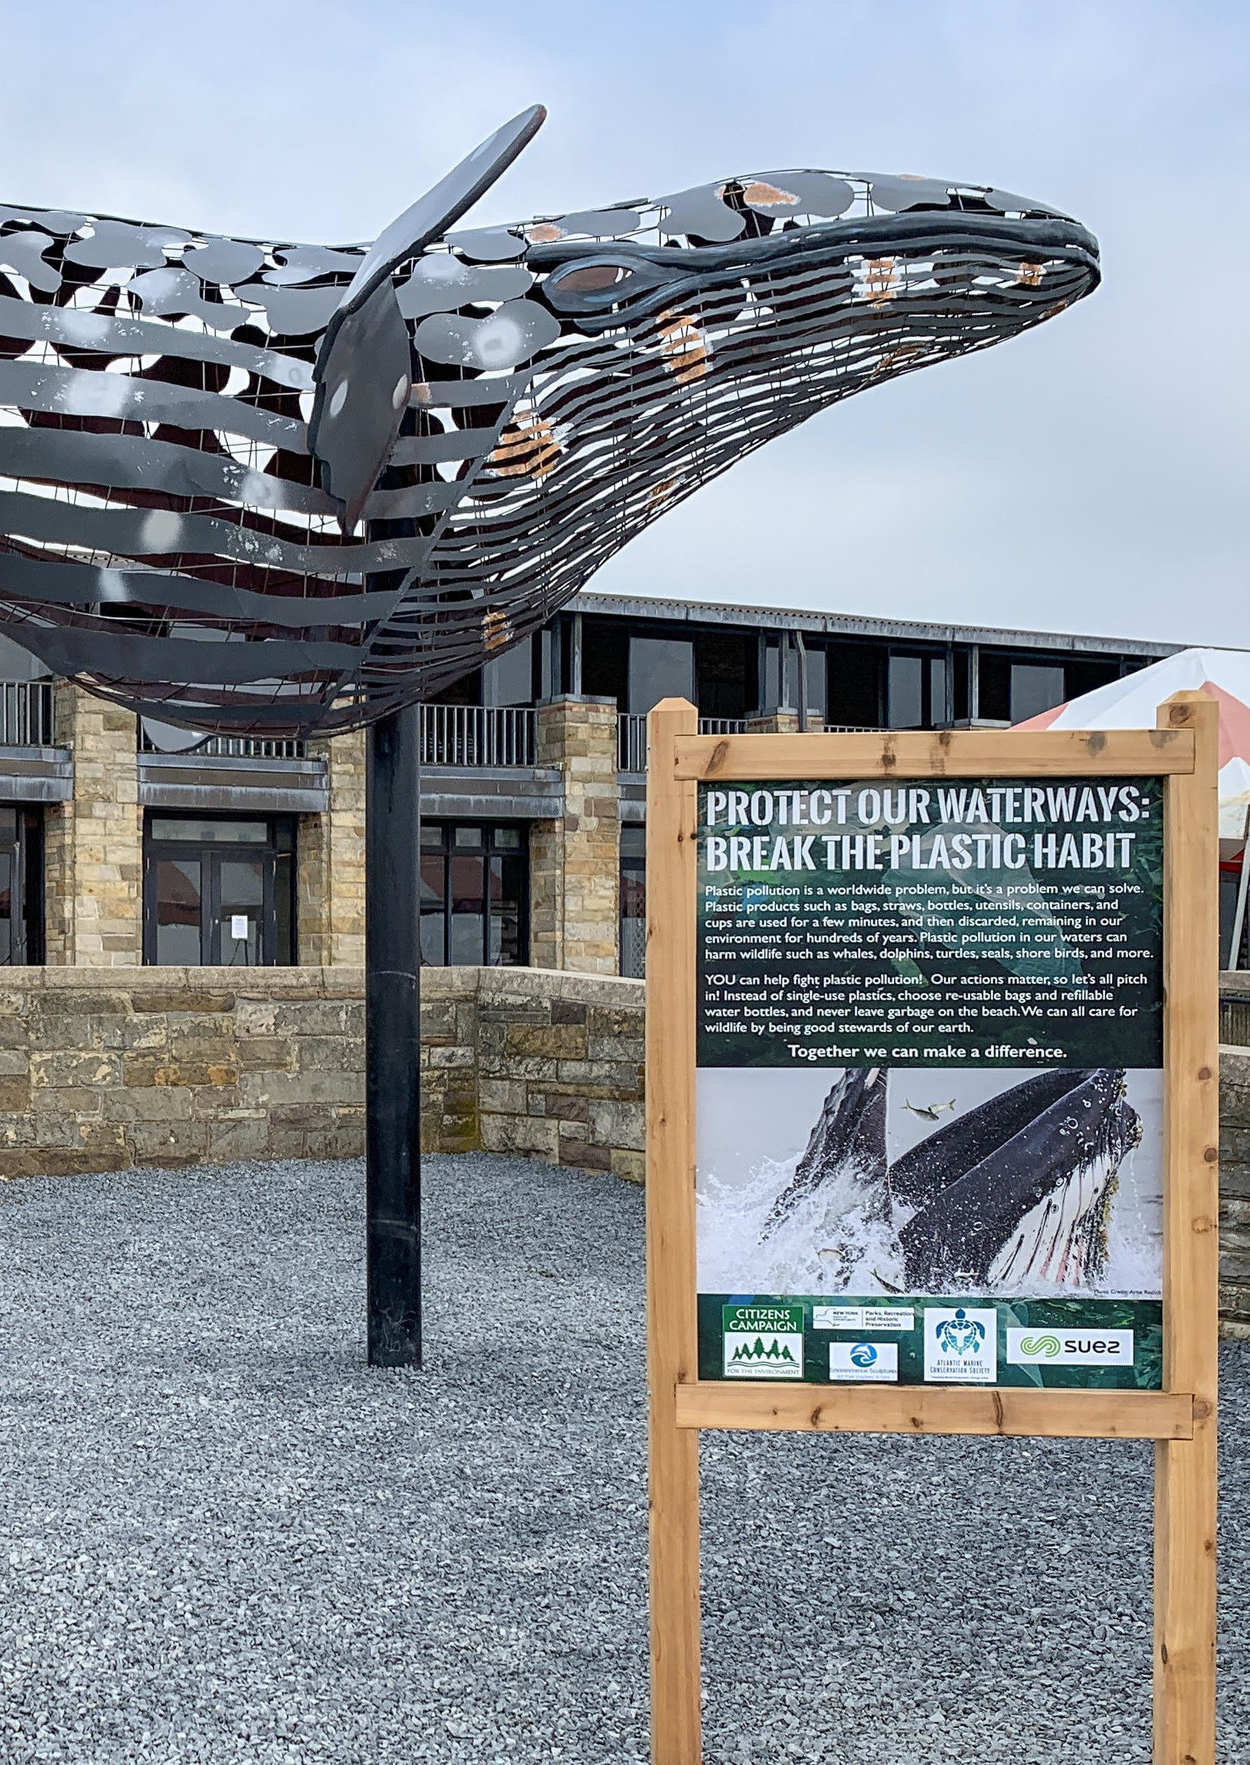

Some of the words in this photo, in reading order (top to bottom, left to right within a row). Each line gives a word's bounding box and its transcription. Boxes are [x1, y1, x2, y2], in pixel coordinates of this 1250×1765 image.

[706, 790, 852, 826] PROTECT
[859, 788, 930, 824] OUR
[938, 786, 1150, 823] WATERWAYS:
[706, 836, 816, 871] BREAK
[821, 835, 884, 870] THE
[891, 834, 1026, 870] PLASTIC
[1034, 832, 1136, 868] HABIT
[705, 885, 743, 895] Plastic
[746, 885, 800, 898] pollution
[804, 885, 813, 895] is
[827, 885, 892, 895] worldwide
[895, 884, 949, 898] problem,
[952, 884, 972, 894] but
[976, 884, 992, 894] it's
[1007, 884, 1058, 897] problem
[1109, 884, 1144, 894] solve.
[705, 901, 743, 911] Plastic
[746, 901, 800, 914] products
[804, 901, 831, 911] such
[852, 901, 880, 914] bags,
[883, 902, 925, 912] straws,
[928, 900, 973, 912] bottles,
[976, 900, 1024, 912] utensils,
[1026, 900, 1094, 912] containers,
[1096, 900, 1118, 910] and
[705, 920, 732, 930] cups
[759, 917, 787, 927] used
[791, 917, 809, 927] for
[822, 917, 845, 927] few
[849, 917, 898, 928] minutes,
[901, 916, 923, 926] and
[927, 916, 954, 926] then
[958, 916, 1019, 928] discarded,
[1022, 916, 1082, 929] remaining
[1086, 916, 1096, 926] in
[705, 933, 782, 943] environment
[785, 933, 803, 943] for
[807, 933, 863, 943] hundreds
[867, 933, 880, 943] of
[883, 935, 917, 946] years.
[920, 932, 958, 942] Plastic
[962, 932, 1016, 945] pollution
[1020, 932, 1030, 942] in
[1060, 933, 1102, 942] waters
[705, 949, 736, 959] harm
[740, 949, 782, 959] wildlife
[786, 949, 813, 959] such
[833, 949, 877, 960] whales,
[880, 949, 933, 962] dolphins,
[936, 948, 979, 960] turtles,
[982, 948, 1013, 960] seals,
[1016, 948, 1050, 958] shore
[1055, 948, 1088, 960] birds,
[1090, 948, 1112, 958] and
[705, 974, 736, 984] YOU
[764, 974, 789, 987] help
[793, 974, 820, 987] fight
[824, 974, 861, 987] plastic
[865, 974, 923, 987] pollution!
[930, 974, 957, 984] Our
[960, 974, 1004, 984] actions
[1008, 975, 1050, 986] matter,
[1072, 974, 1096, 984] let's
[1099, 974, 1113, 984] all
[1117, 974, 1148, 987] pitch
[705, 990, 720, 1000] in!
[724, 990, 767, 1000] Instead
[770, 990, 784, 1000] of
[786, 990, 845, 1003] single-use
[849, 990, 895, 1003] plastics,
[898, 990, 941, 1000] choose
[946, 990, 1001, 1000] re-usable
[1005, 990, 1031, 1003] bags
[1035, 990, 1057, 1000] and
[1061, 990, 1113, 1000] refillable
[705, 1008, 740, 1016] water
[744, 1006, 788, 1018] bottles,
[791, 1006, 813, 1016] and
[854, 1006, 884, 1016] leave
[888, 1006, 934, 1019] garbage
[958, 1006, 978, 1016] the
[982, 1006, 1020, 1016] beach.
[1020, 1006, 1043, 1016] We
[1071, 1006, 1085, 1016] all
[1119, 1006, 1138, 1016] for
[705, 1022, 747, 1032] wildlife
[751, 1022, 765, 1035] by
[769, 1022, 800, 1035] being
[804, 1022, 835, 1035] good
[838, 1022, 893, 1032] stewards
[896, 1022, 909, 1032] of
[938, 1022, 974, 1032] earth.
[787, 1045, 860, 1060] Together
[864, 1048, 887, 1057] we
[892, 1048, 918, 1057] can
[923, 1045, 966, 1057] make
[971, 1048, 980, 1057] a
[984, 1045, 1067, 1057] difference.
[736, 1309, 790, 1320] CITIZENS
[729, 1320, 796, 1332] CAMPAIGN
